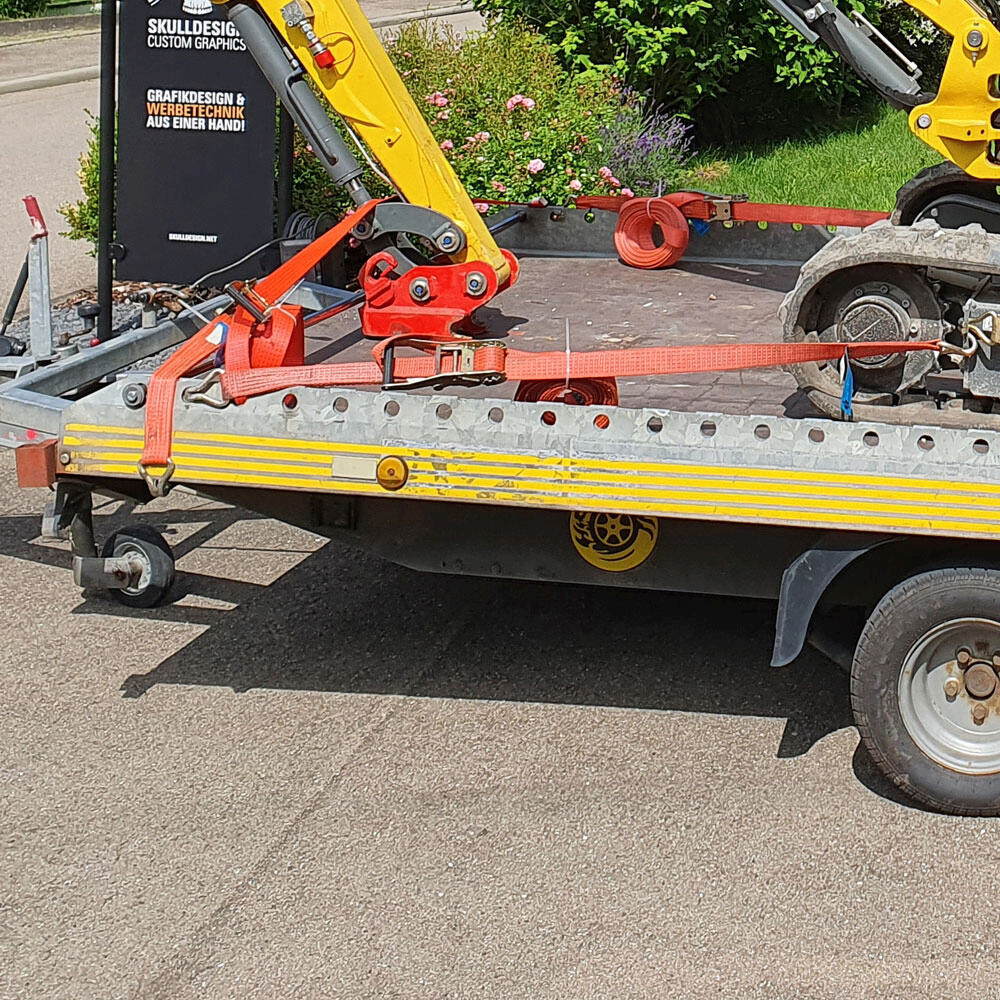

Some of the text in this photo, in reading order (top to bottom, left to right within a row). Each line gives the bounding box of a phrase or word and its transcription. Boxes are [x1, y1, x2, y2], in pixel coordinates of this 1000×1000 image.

[147, 34, 247, 51] CUSTOM GRAPHICS
[147, 88, 246, 106] GRAFIKDESIGN &
[146, 102, 245, 119] WERBETECHNIK
[146, 115, 245, 132] AUS EINER HAND!
